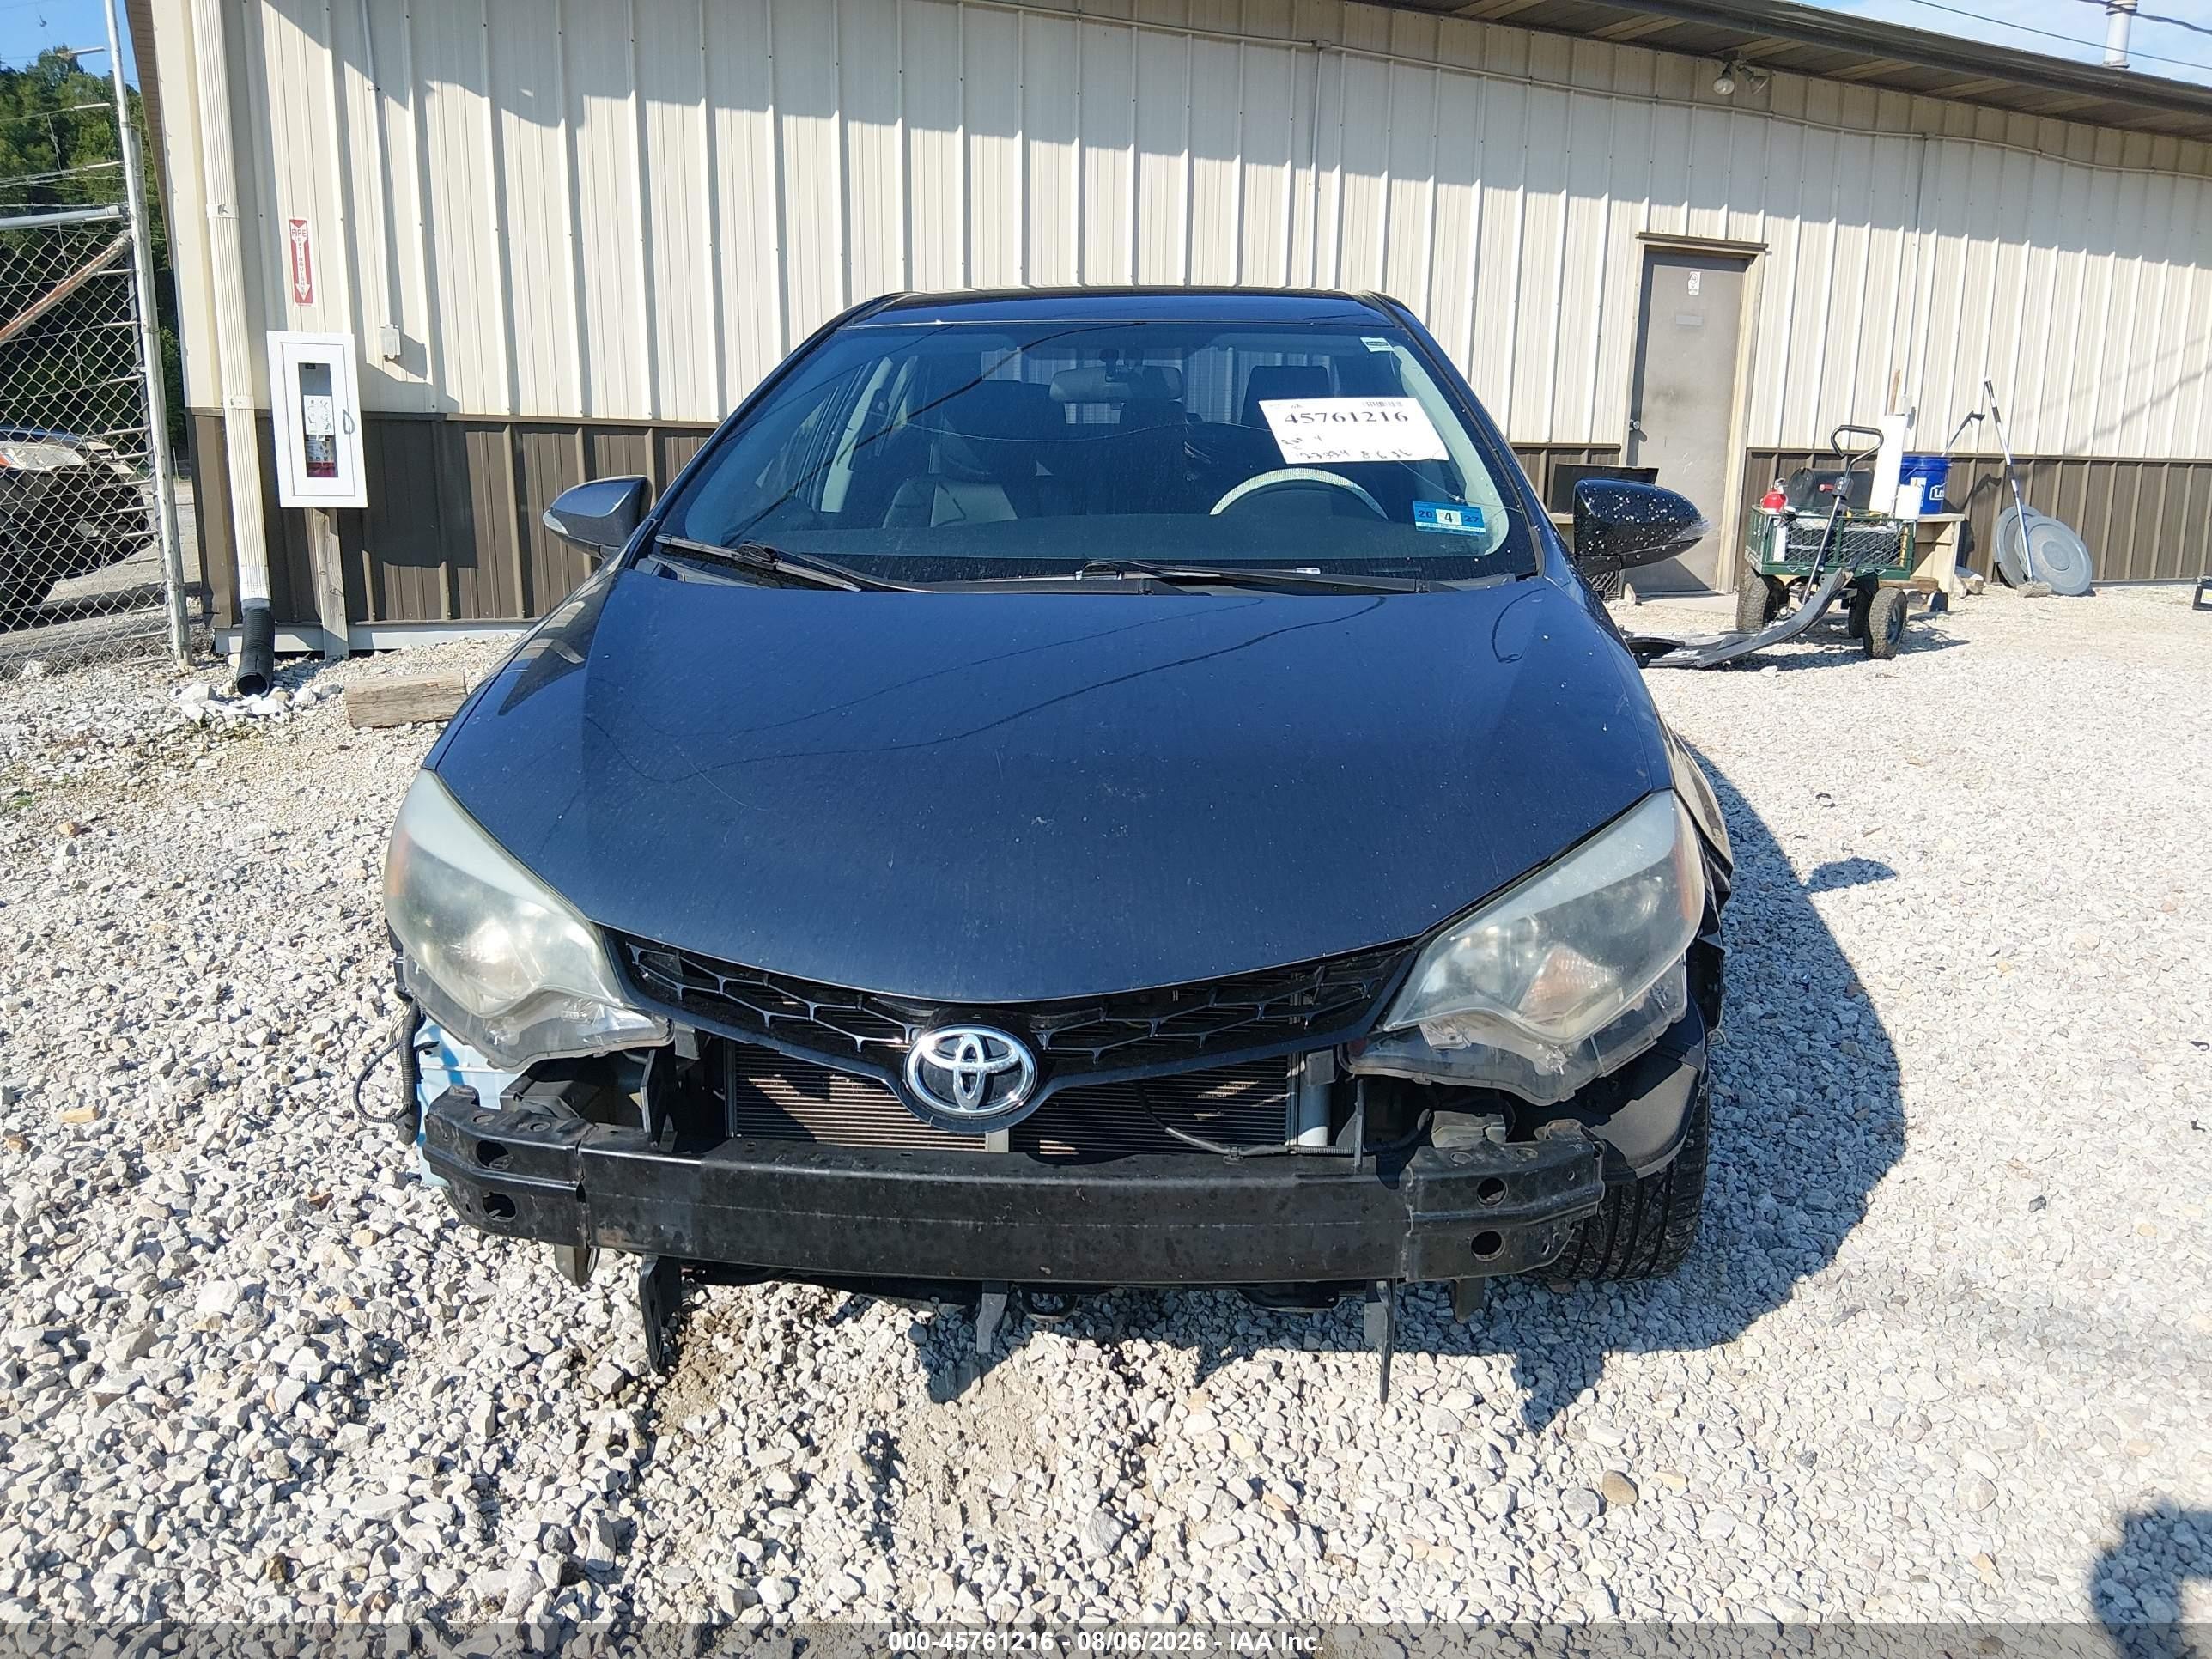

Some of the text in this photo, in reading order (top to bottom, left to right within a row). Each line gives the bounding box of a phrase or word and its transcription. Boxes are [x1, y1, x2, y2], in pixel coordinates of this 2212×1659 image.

[1285, 411, 1408, 424] 45761216
[1418, 510, 1433, 519] 20
[1444, 513, 1453, 523] 4
